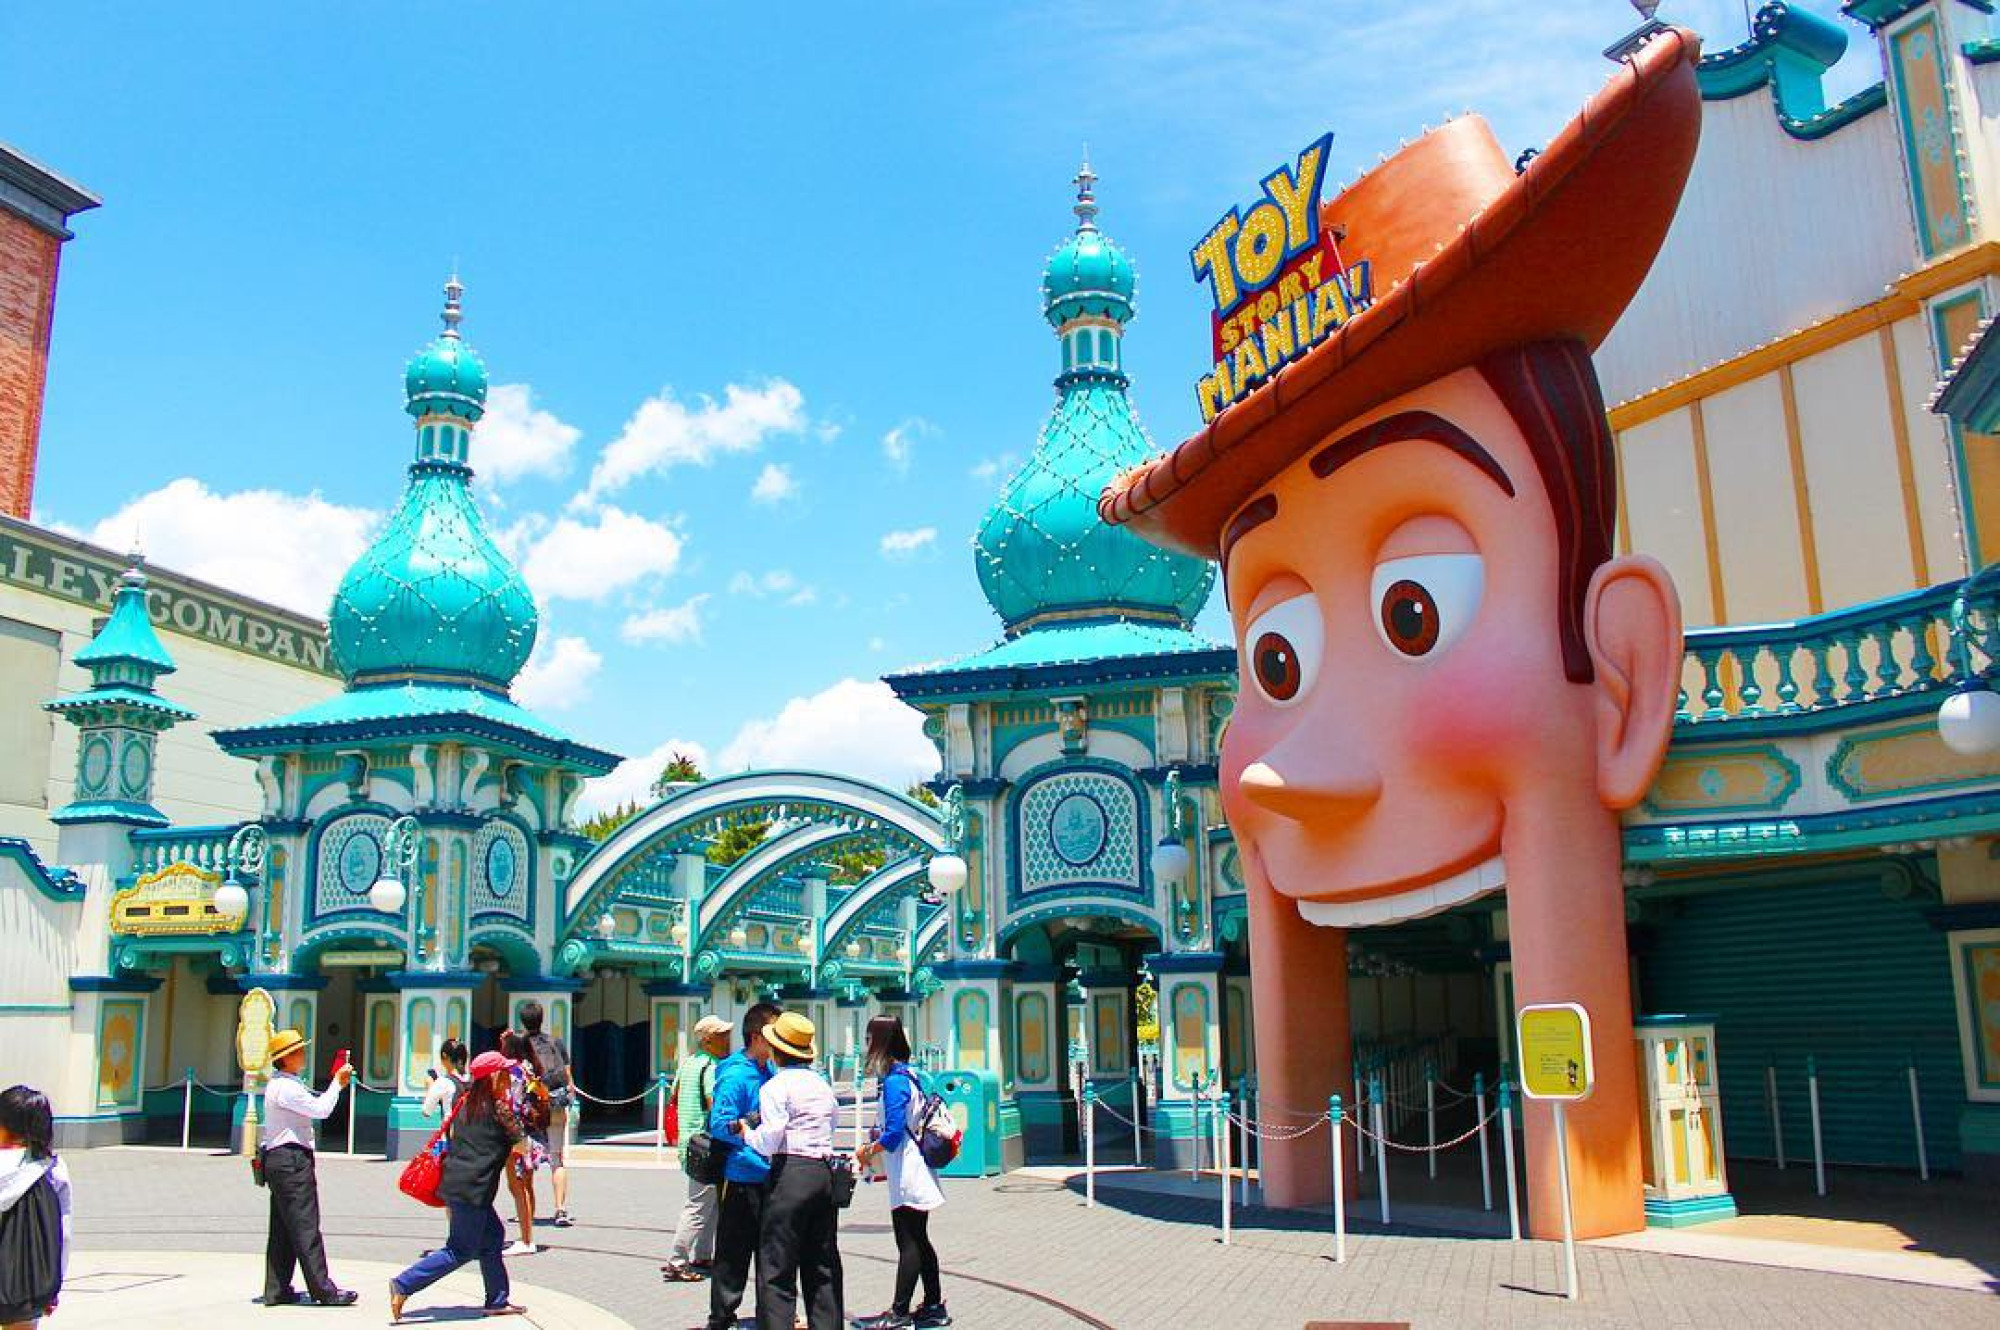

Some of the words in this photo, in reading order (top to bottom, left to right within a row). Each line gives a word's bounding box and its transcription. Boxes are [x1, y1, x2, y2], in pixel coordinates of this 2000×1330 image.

[1192, 143, 1325, 312] TOY
[1197, 263, 1366, 423] MANIA!
[1219, 250, 1324, 353] STORY
[146, 589, 332, 670] COMPAN
